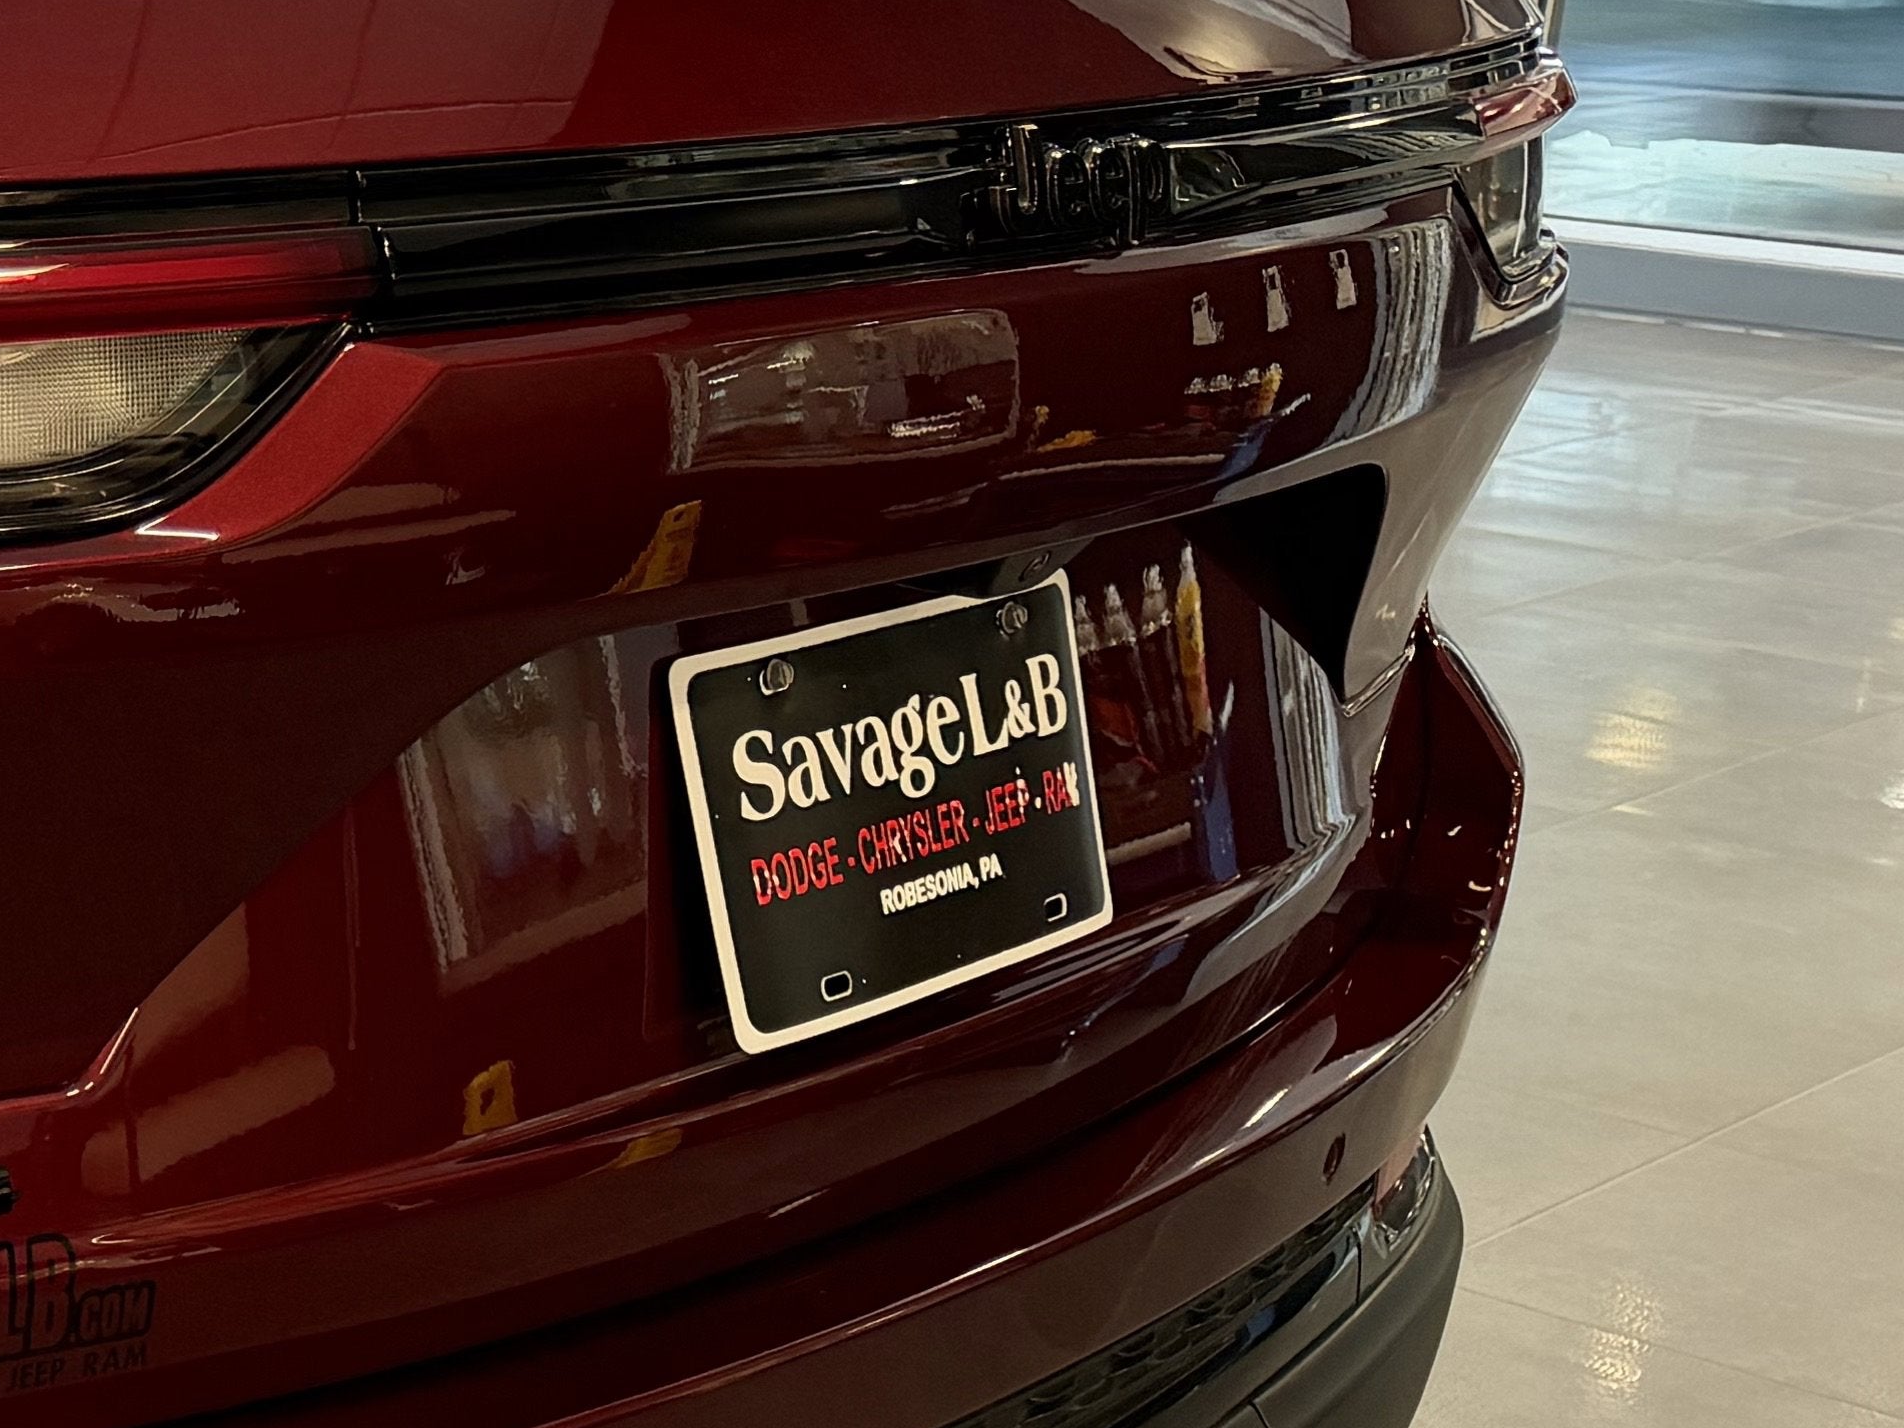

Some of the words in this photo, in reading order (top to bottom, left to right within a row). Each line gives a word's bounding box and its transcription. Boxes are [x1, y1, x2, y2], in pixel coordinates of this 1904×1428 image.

[750, 837, 845, 907] DODGE
[857, 799, 970, 875] CHRYSLER
[984, 777, 1031, 836] JEEP
[879, 862, 980, 916] ROBESONIA,
[979, 853, 1004, 881] PA
[9, 1359, 66, 1394] JEEP
[83, 1344, 150, 1379] RAM
